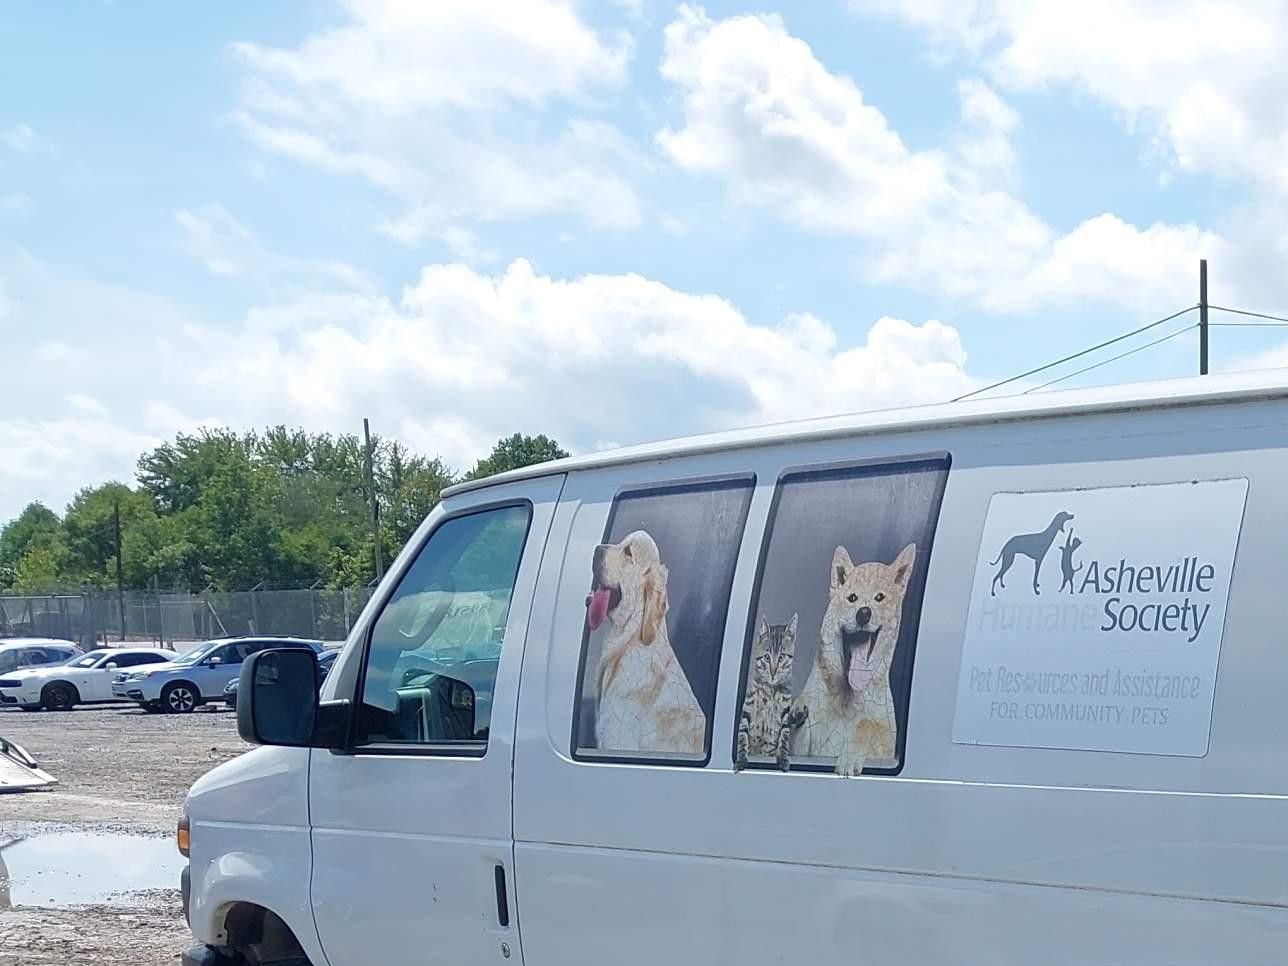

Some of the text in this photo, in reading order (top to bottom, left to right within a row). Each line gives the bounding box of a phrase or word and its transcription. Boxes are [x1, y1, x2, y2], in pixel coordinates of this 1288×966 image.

[1079, 556, 1215, 594] Asheville
[1100, 597, 1211, 643] Society
[969, 665, 1201, 699] Pet Resurces and Assistance
[989, 701, 1170, 726] FOR COMMUNITY PETS
